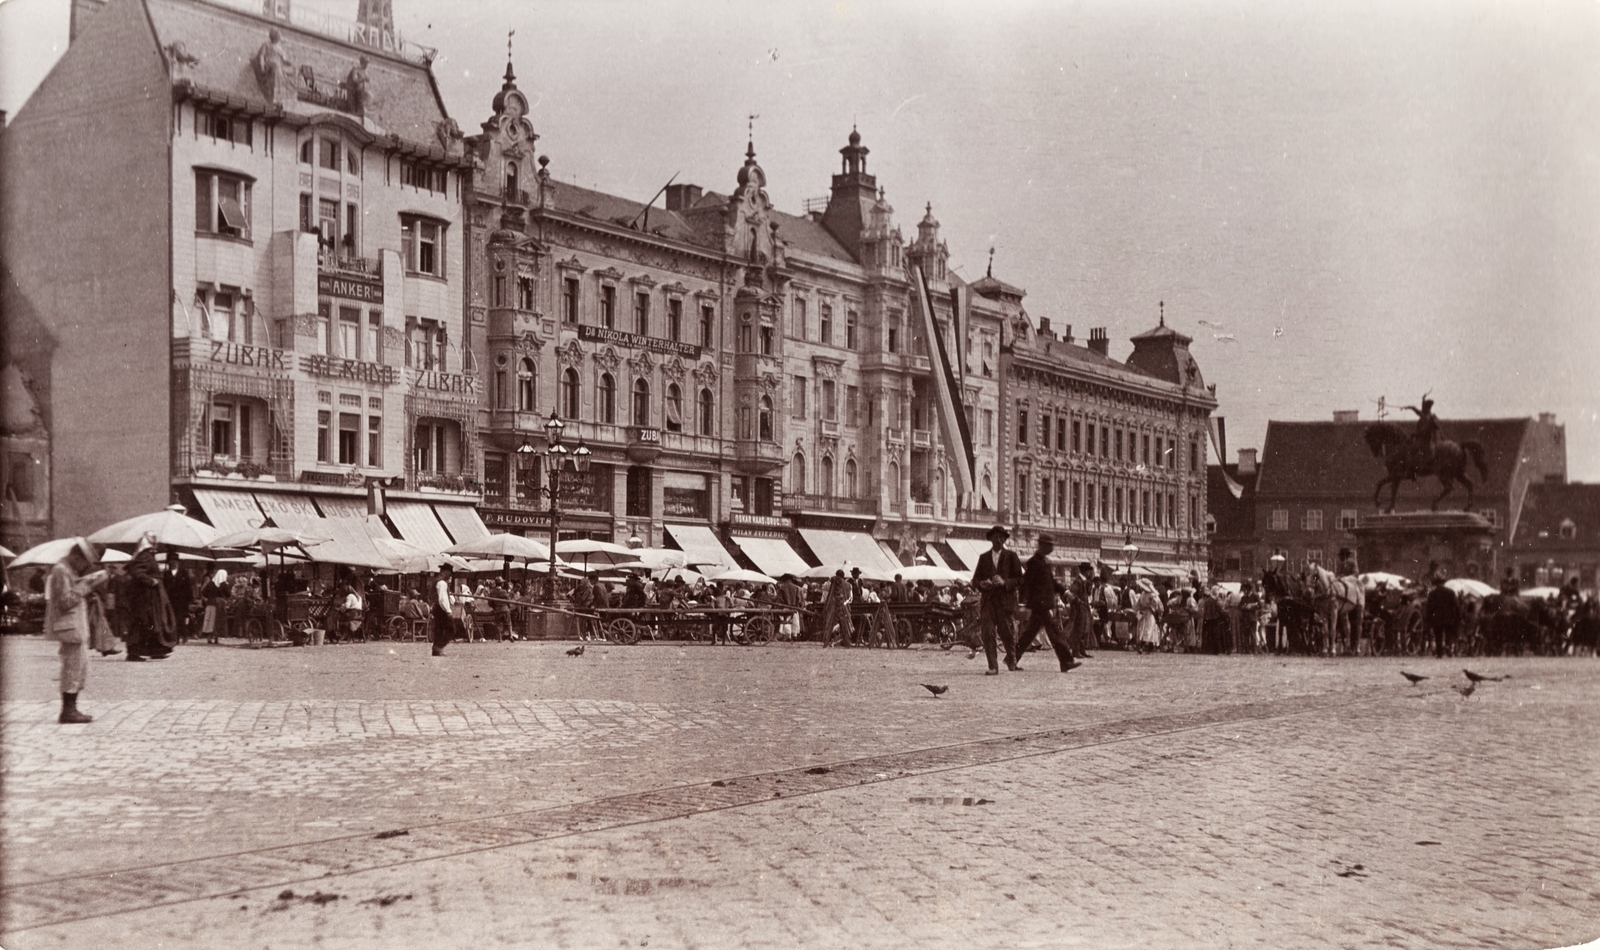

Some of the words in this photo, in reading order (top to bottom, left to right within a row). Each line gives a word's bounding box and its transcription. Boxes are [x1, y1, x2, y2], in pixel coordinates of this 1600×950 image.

[332, 280, 371, 299] ANKER
[597, 329, 629, 342] NIKOLA
[631, 334, 695, 355] WINTERHALTER
[211, 341, 284, 370] ZUBAR
[415, 369, 474, 395] ZUBAR
